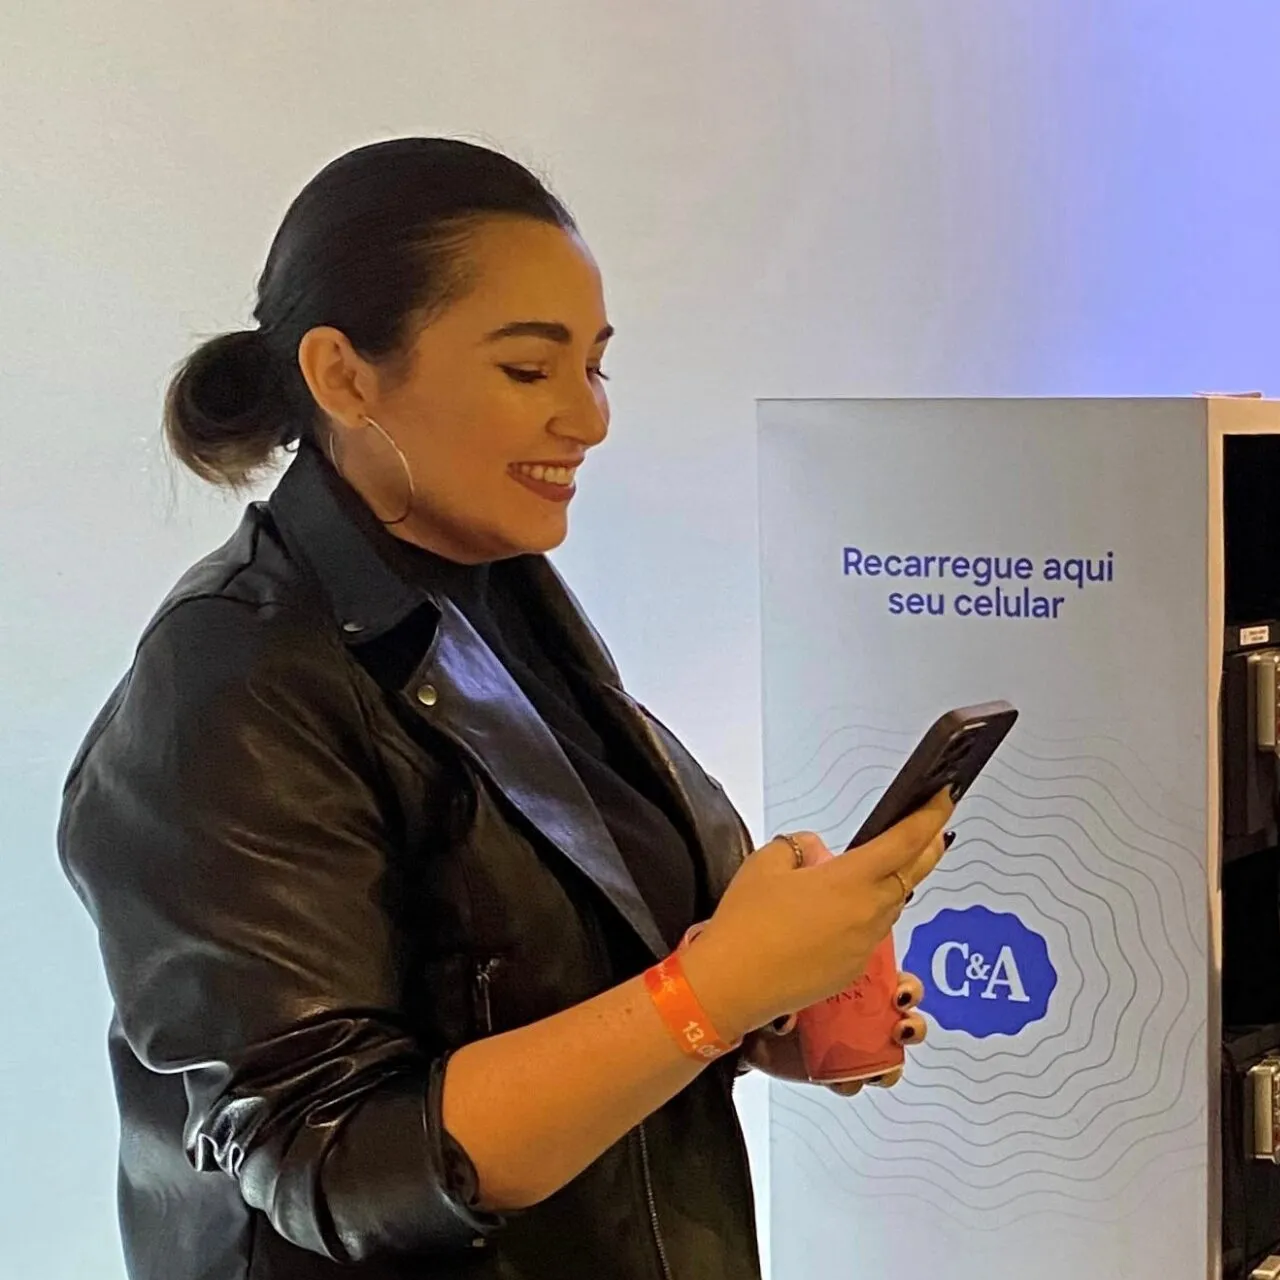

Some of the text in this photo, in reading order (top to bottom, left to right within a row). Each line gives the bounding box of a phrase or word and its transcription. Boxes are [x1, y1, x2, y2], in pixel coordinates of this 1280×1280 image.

[843, 547, 1114, 589] Recarregue aqui
[888, 587, 1064, 618] seu celular
[931, 941, 1030, 1002] C&A
